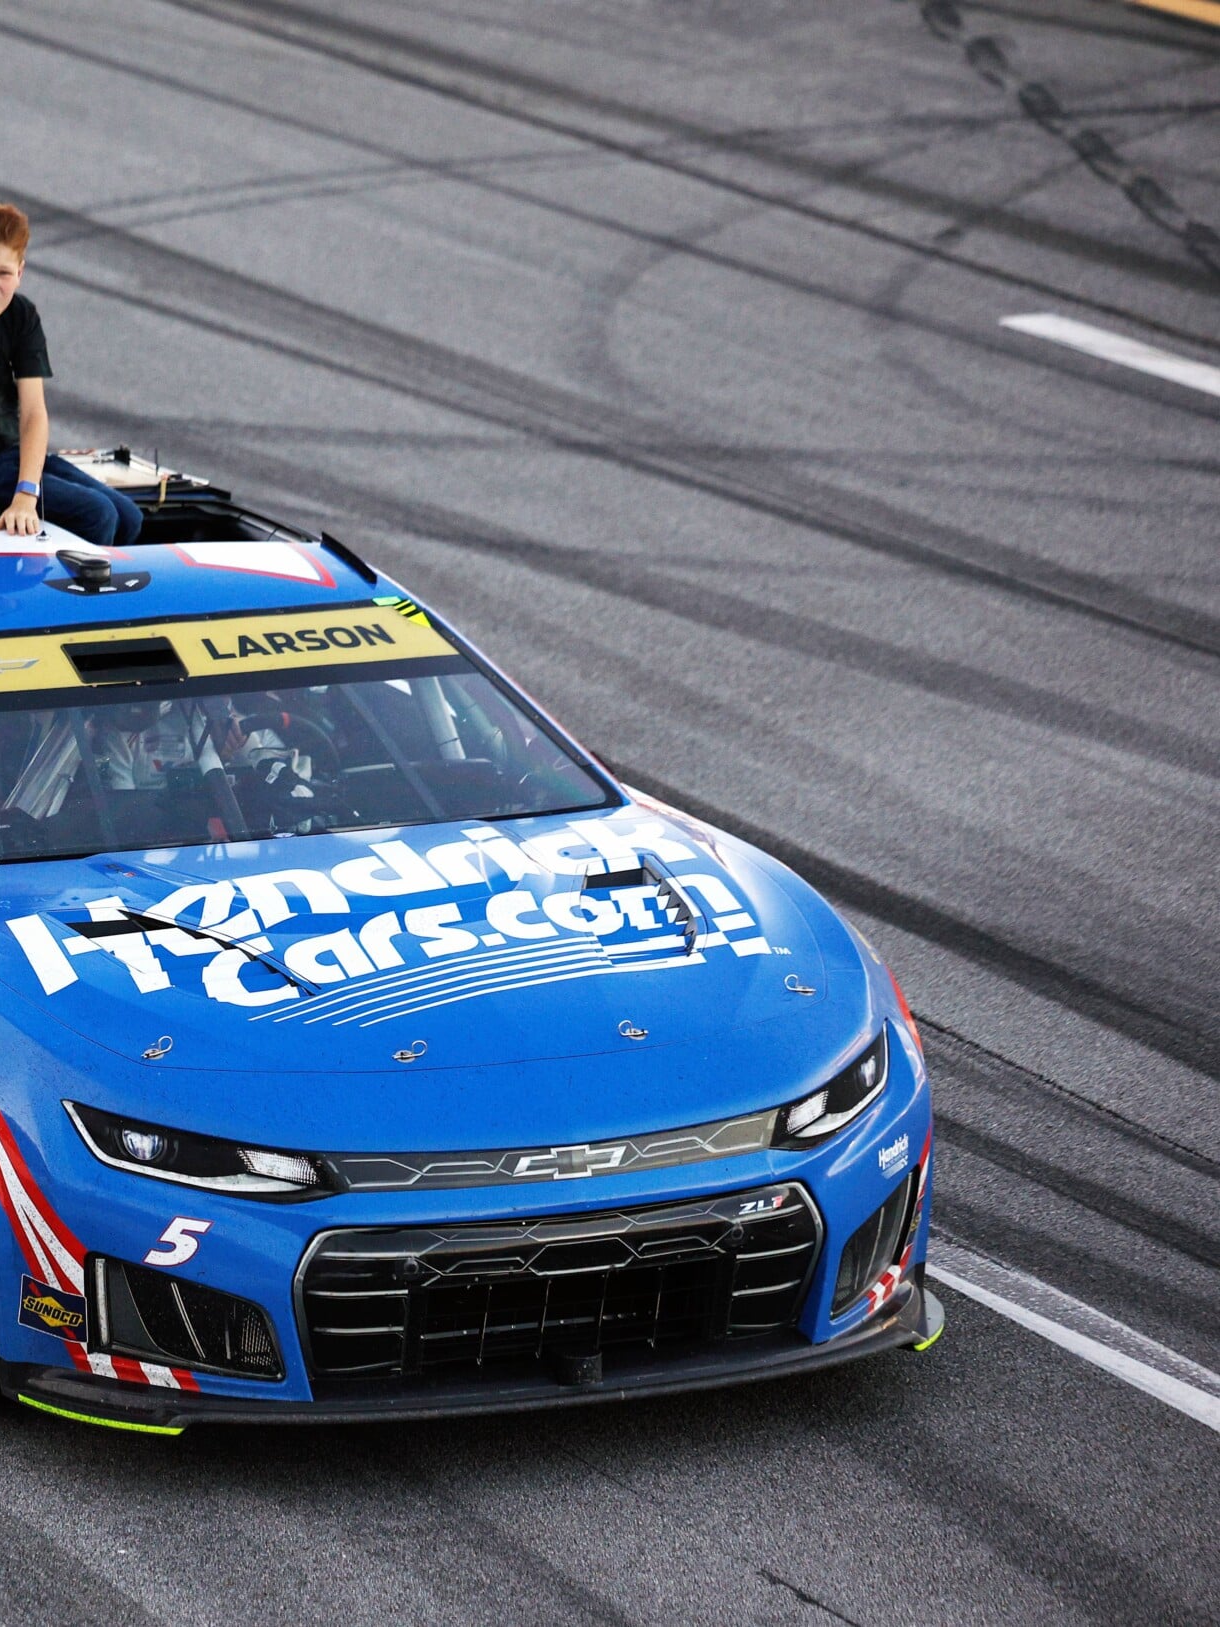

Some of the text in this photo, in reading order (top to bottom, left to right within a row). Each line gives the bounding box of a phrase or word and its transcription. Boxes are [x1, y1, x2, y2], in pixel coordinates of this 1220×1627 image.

[201, 624, 396, 660] LARSON
[5, 819, 698, 996] Hendrick
[738, 1195, 783, 1215] ZL1
[142, 1216, 214, 1267] 5
[25, 1298, 80, 1325] SUNOCO
